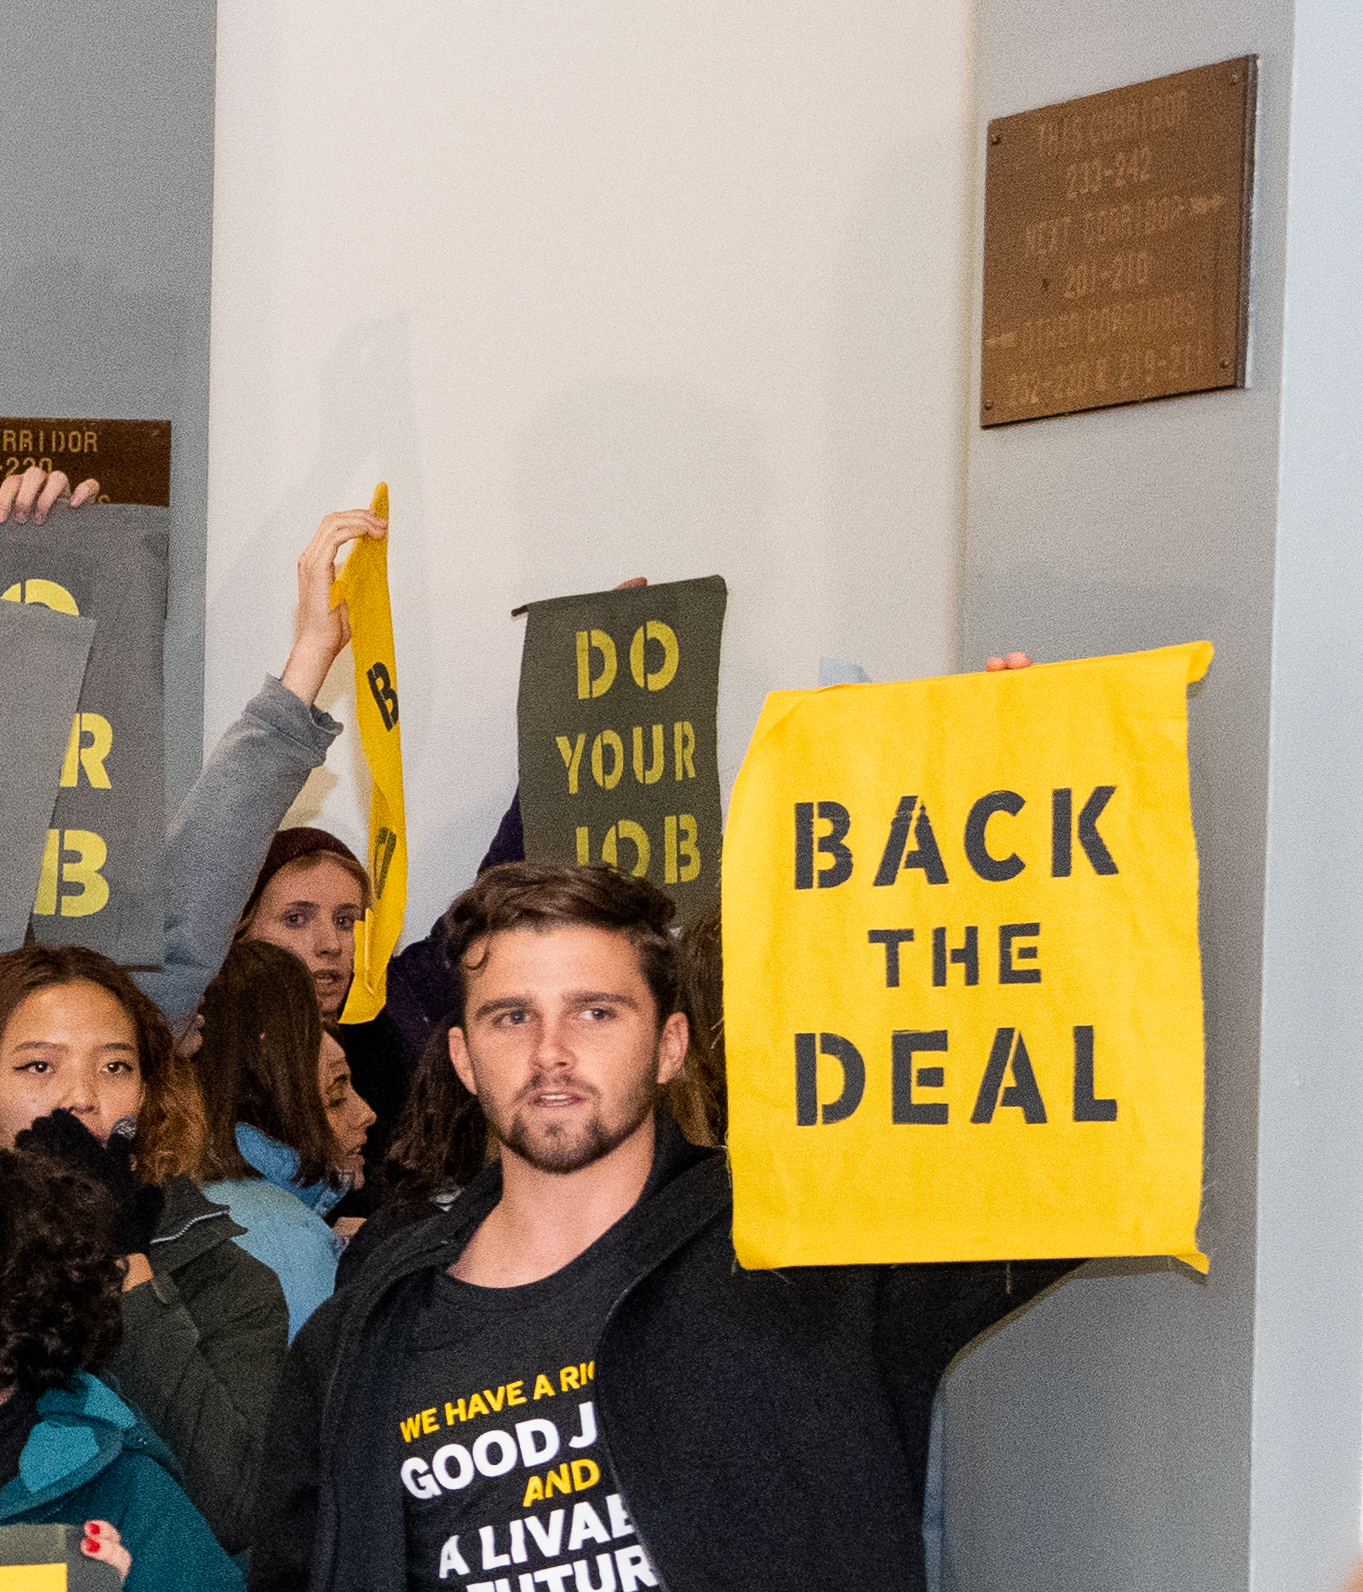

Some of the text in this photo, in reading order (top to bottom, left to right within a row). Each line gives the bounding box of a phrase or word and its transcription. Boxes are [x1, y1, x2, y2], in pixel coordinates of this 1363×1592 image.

[575, 620, 680, 700] DO
[555, 721, 696, 794] YOUR
[793, 785, 1120, 890] BACK
[868, 922, 1043, 988] THE
[793, 1025, 1119, 1127] DEAL
[399, 1407, 440, 1443] WE
[444, 1380, 527, 1426] HAVE
[533, 1374, 555, 1401] A
[400, 1418, 561, 1500] GOOD
[523, 1458, 601, 1508] AND
[438, 1534, 470, 1579] A
